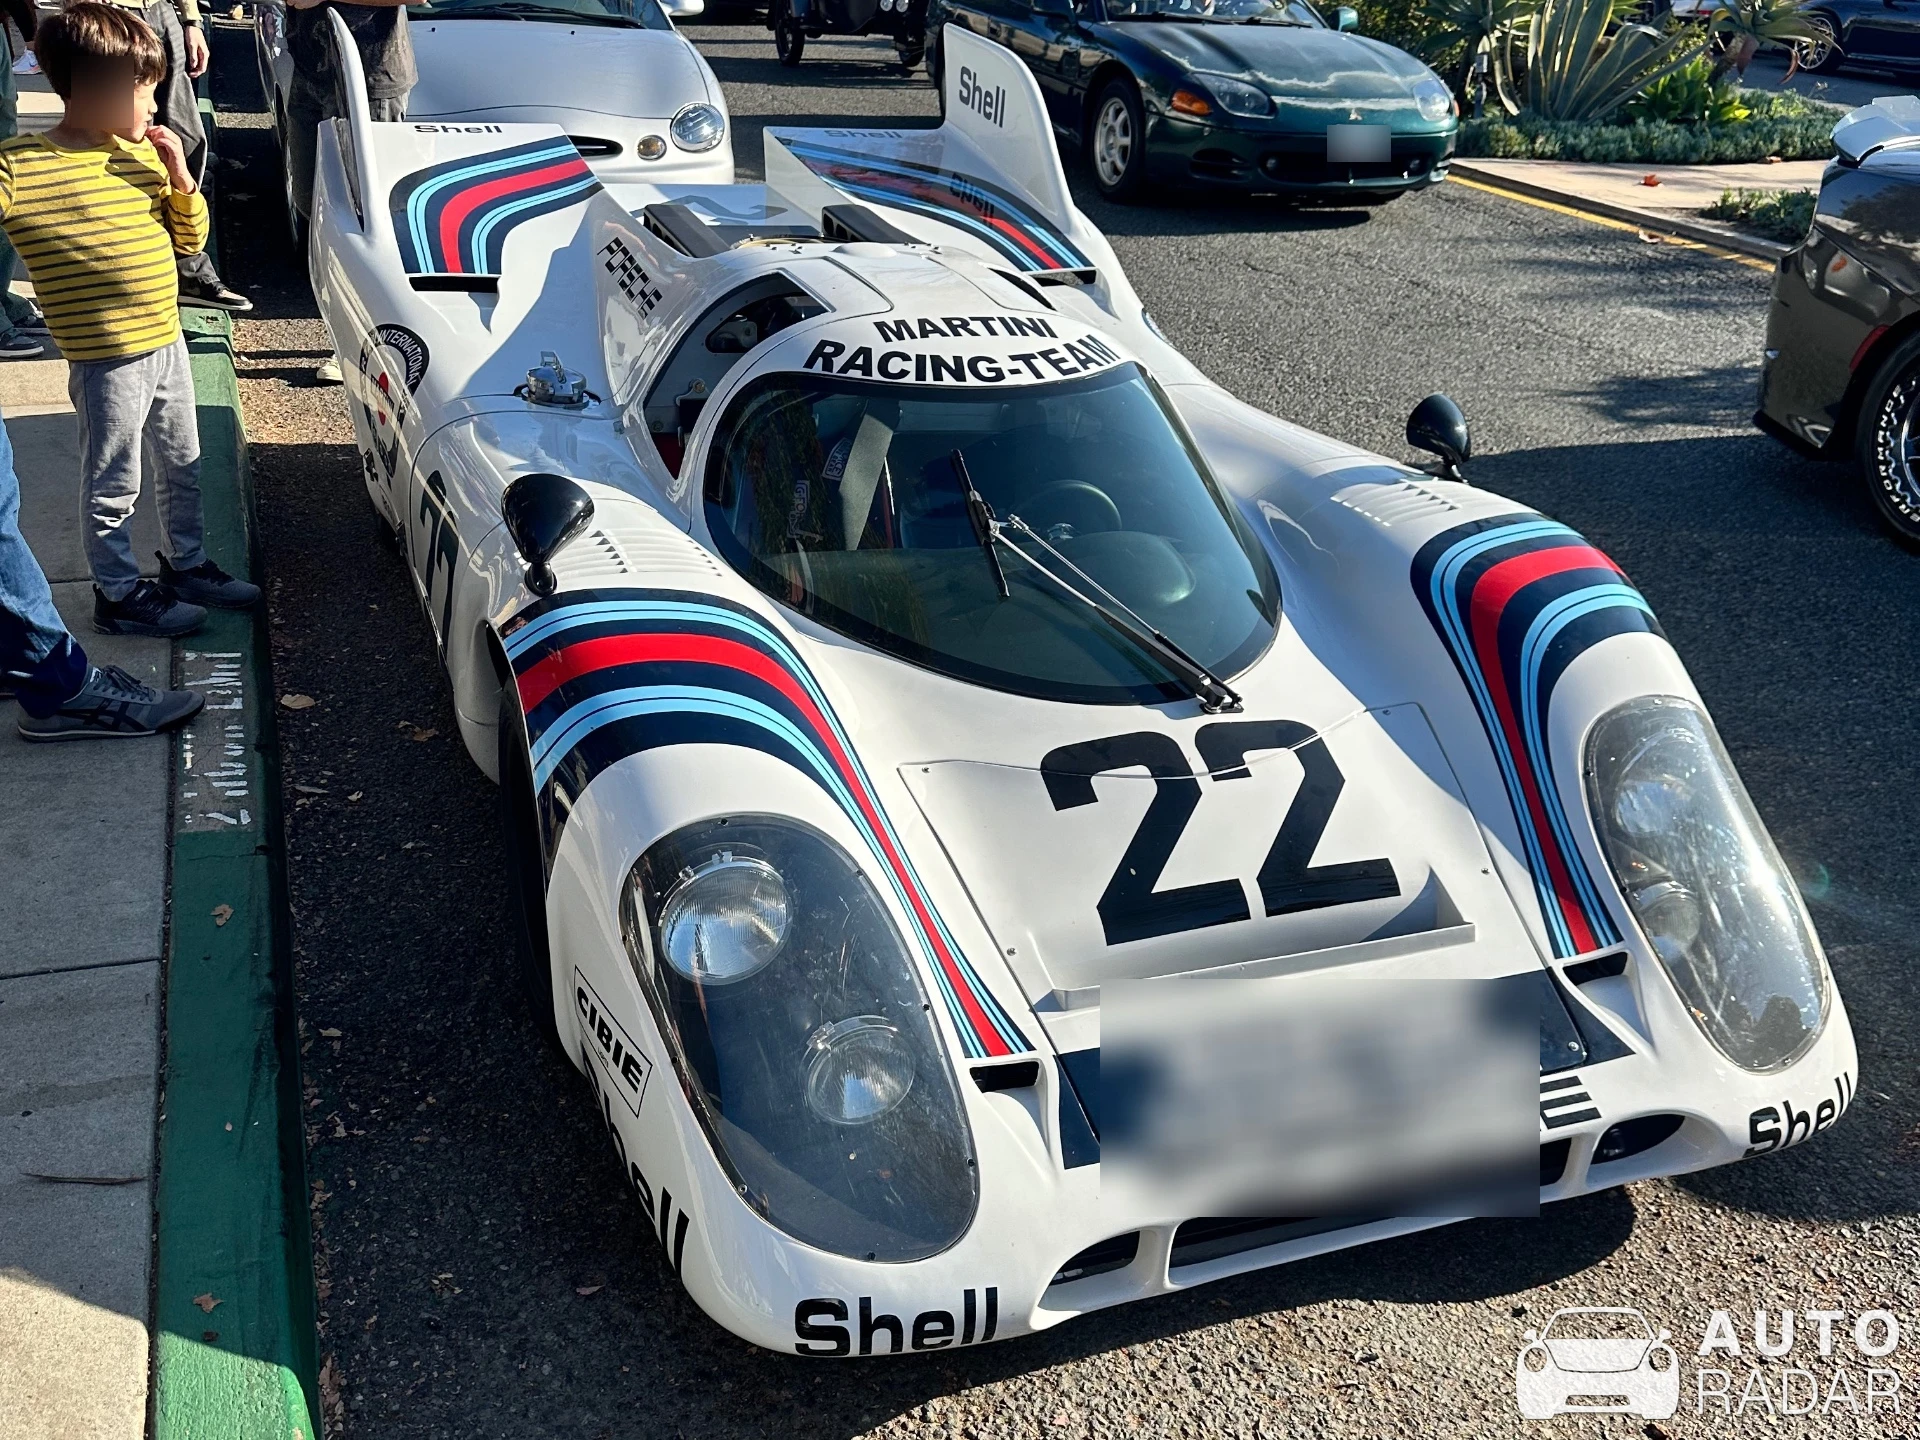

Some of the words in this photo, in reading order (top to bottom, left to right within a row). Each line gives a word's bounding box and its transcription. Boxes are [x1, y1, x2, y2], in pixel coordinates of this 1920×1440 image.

[959, 65, 1006, 129] Shell
[414, 124, 503, 135] Shell
[824, 129, 903, 139] Shell
[596, 236, 663, 321] PORSCHE
[802, 333, 1120, 385] RACING-TEAM
[873, 315, 1056, 344] MARTINI
[1041, 719, 1400, 946] 22
[1741, 1072, 1853, 1159] Shell
[794, 1286, 999, 1358] Shell
